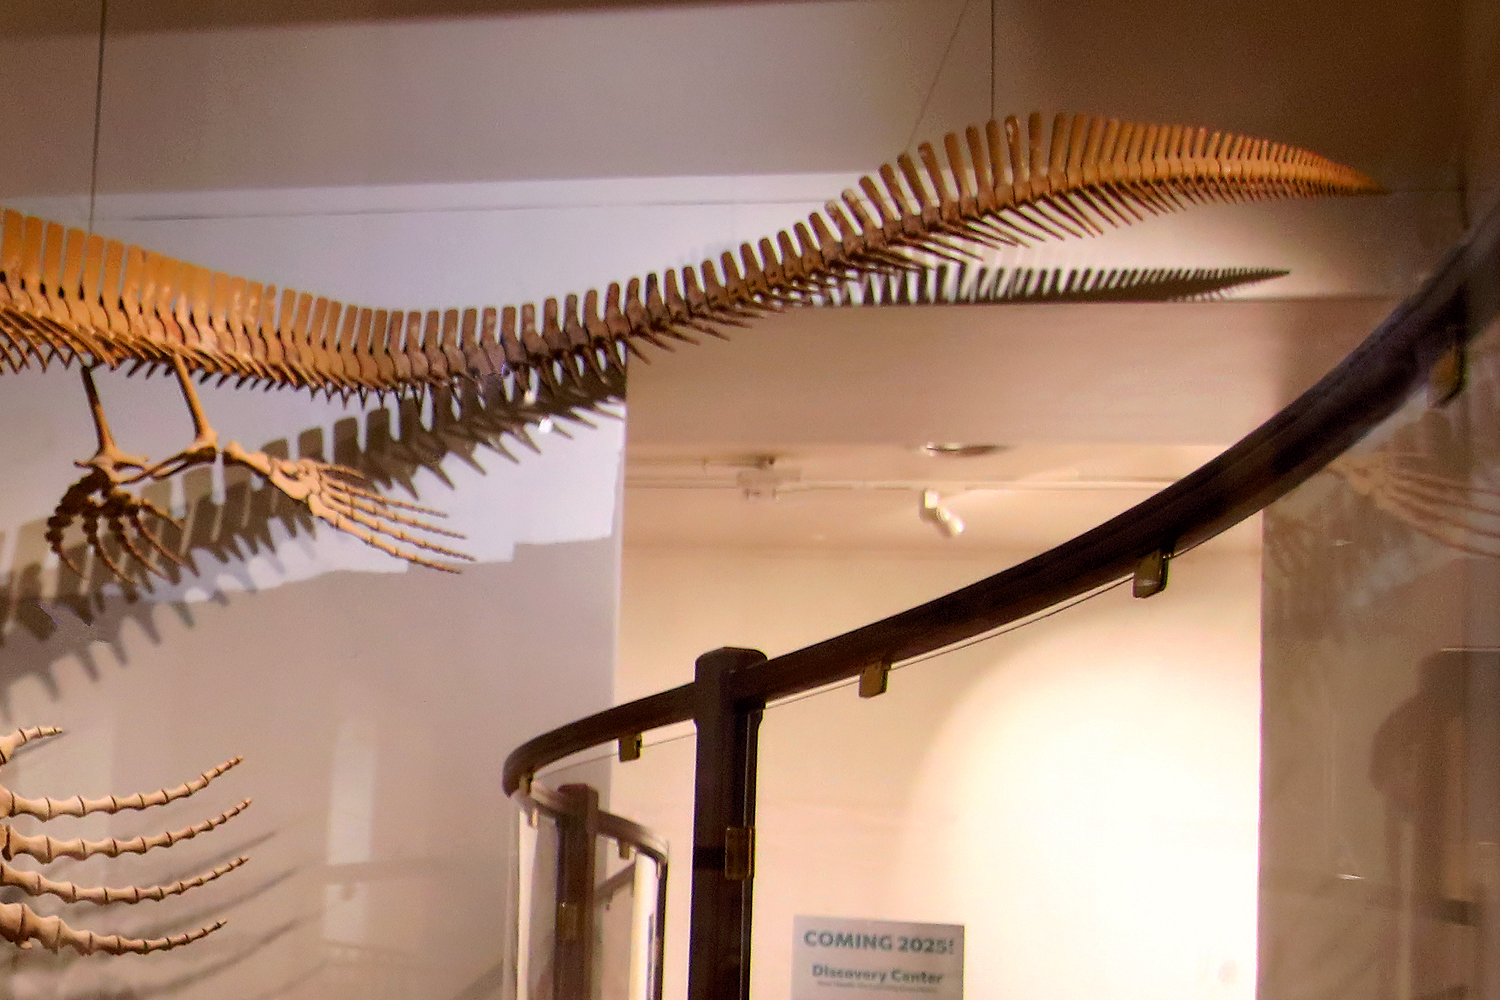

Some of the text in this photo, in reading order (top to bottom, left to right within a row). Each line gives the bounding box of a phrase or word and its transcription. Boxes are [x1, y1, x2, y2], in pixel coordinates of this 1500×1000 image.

[803, 930, 954, 955] COMING 2025!
[812, 963, 944, 984] Discovery Center
